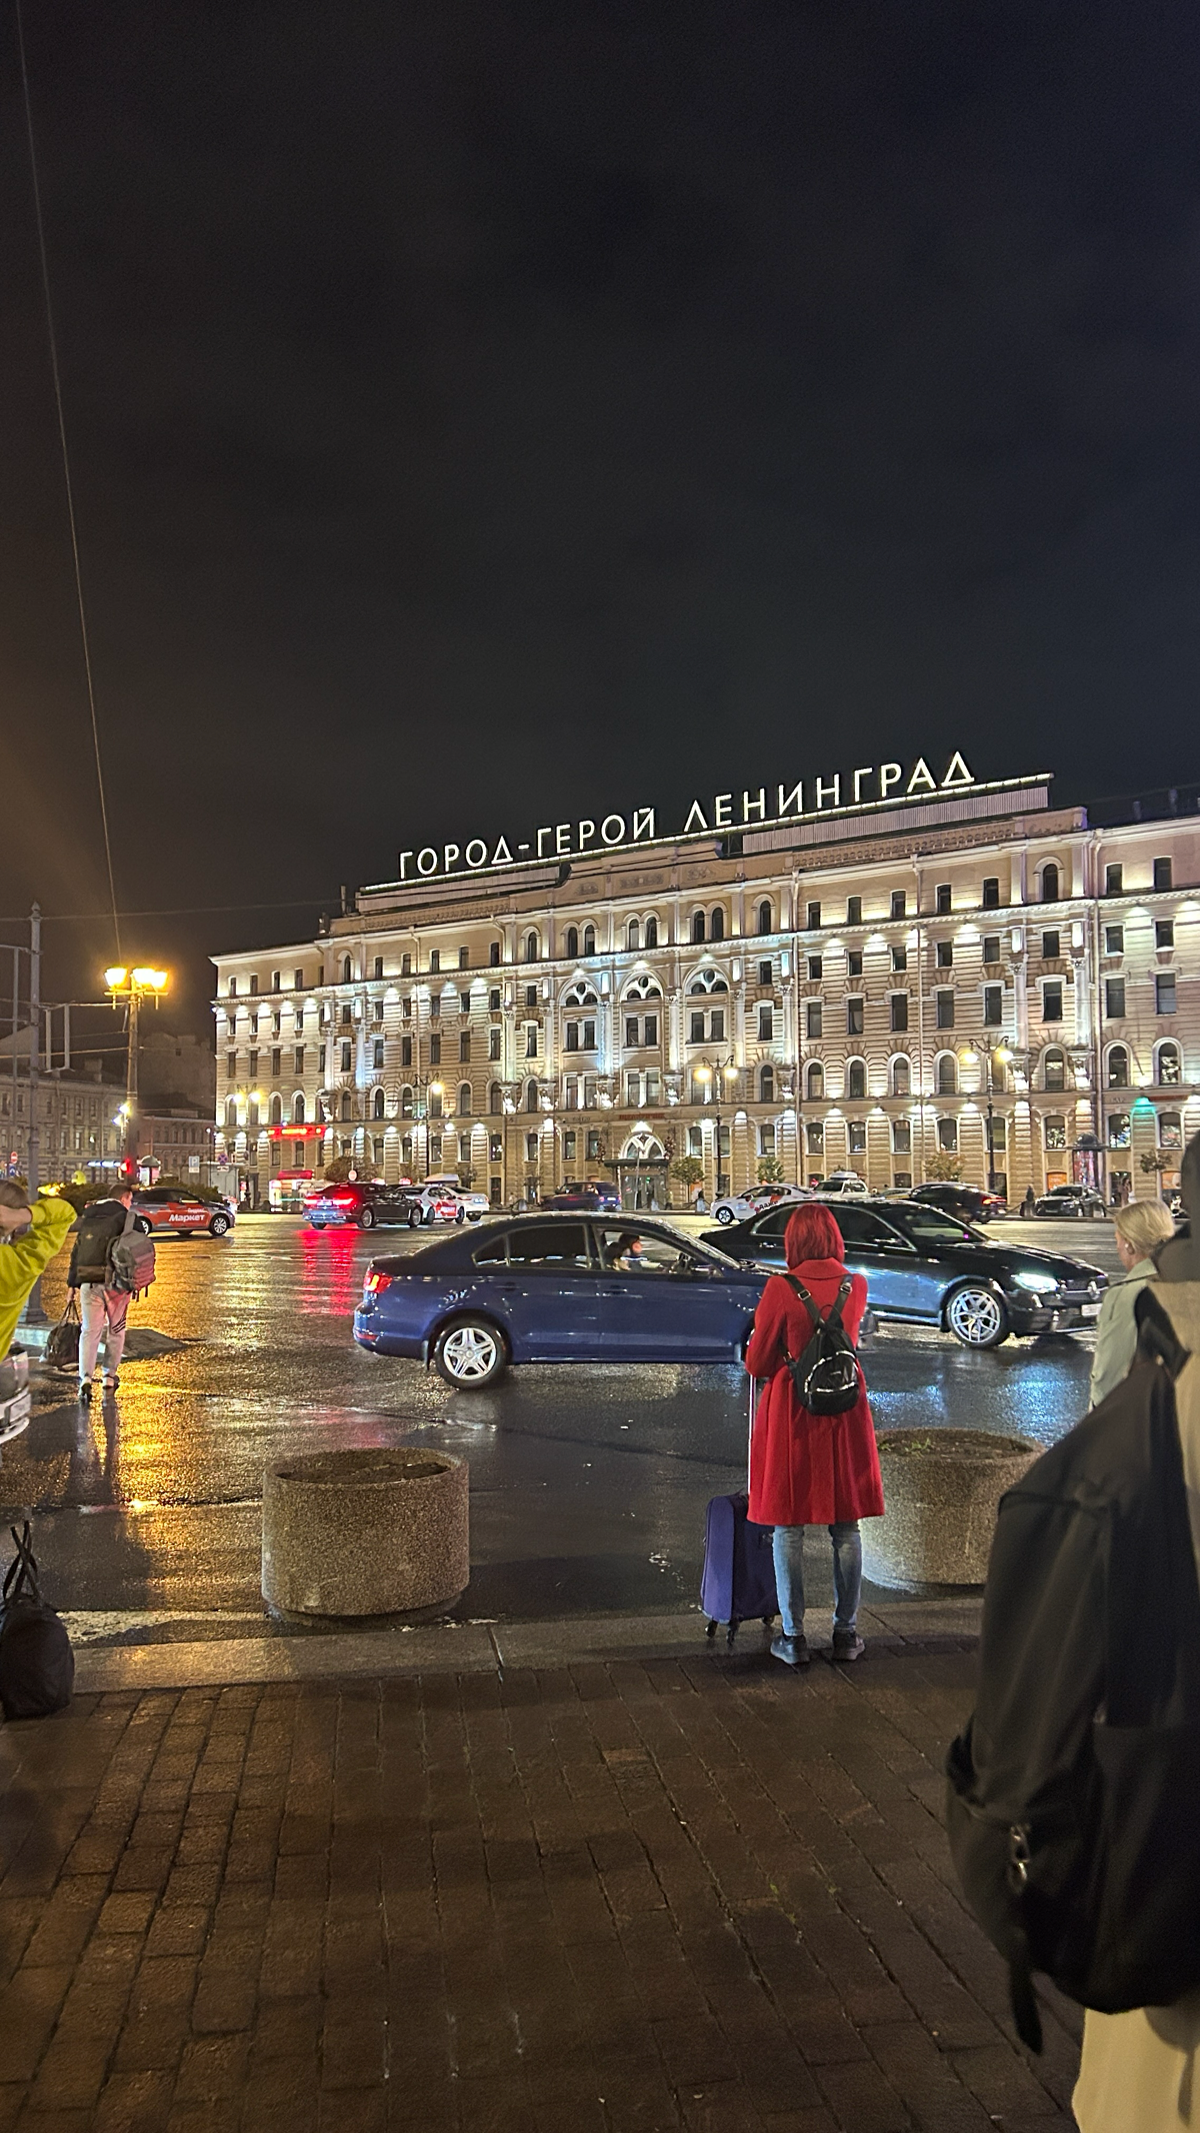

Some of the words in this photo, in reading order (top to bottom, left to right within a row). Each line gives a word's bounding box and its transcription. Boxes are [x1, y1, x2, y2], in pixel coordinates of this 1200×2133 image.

[400, 807, 655, 880] ГОРОД-ГЕРОЙ
[683, 750, 975, 832] ЛЕНИНГРАД
[168, 1214, 205, 1222] Маркет
